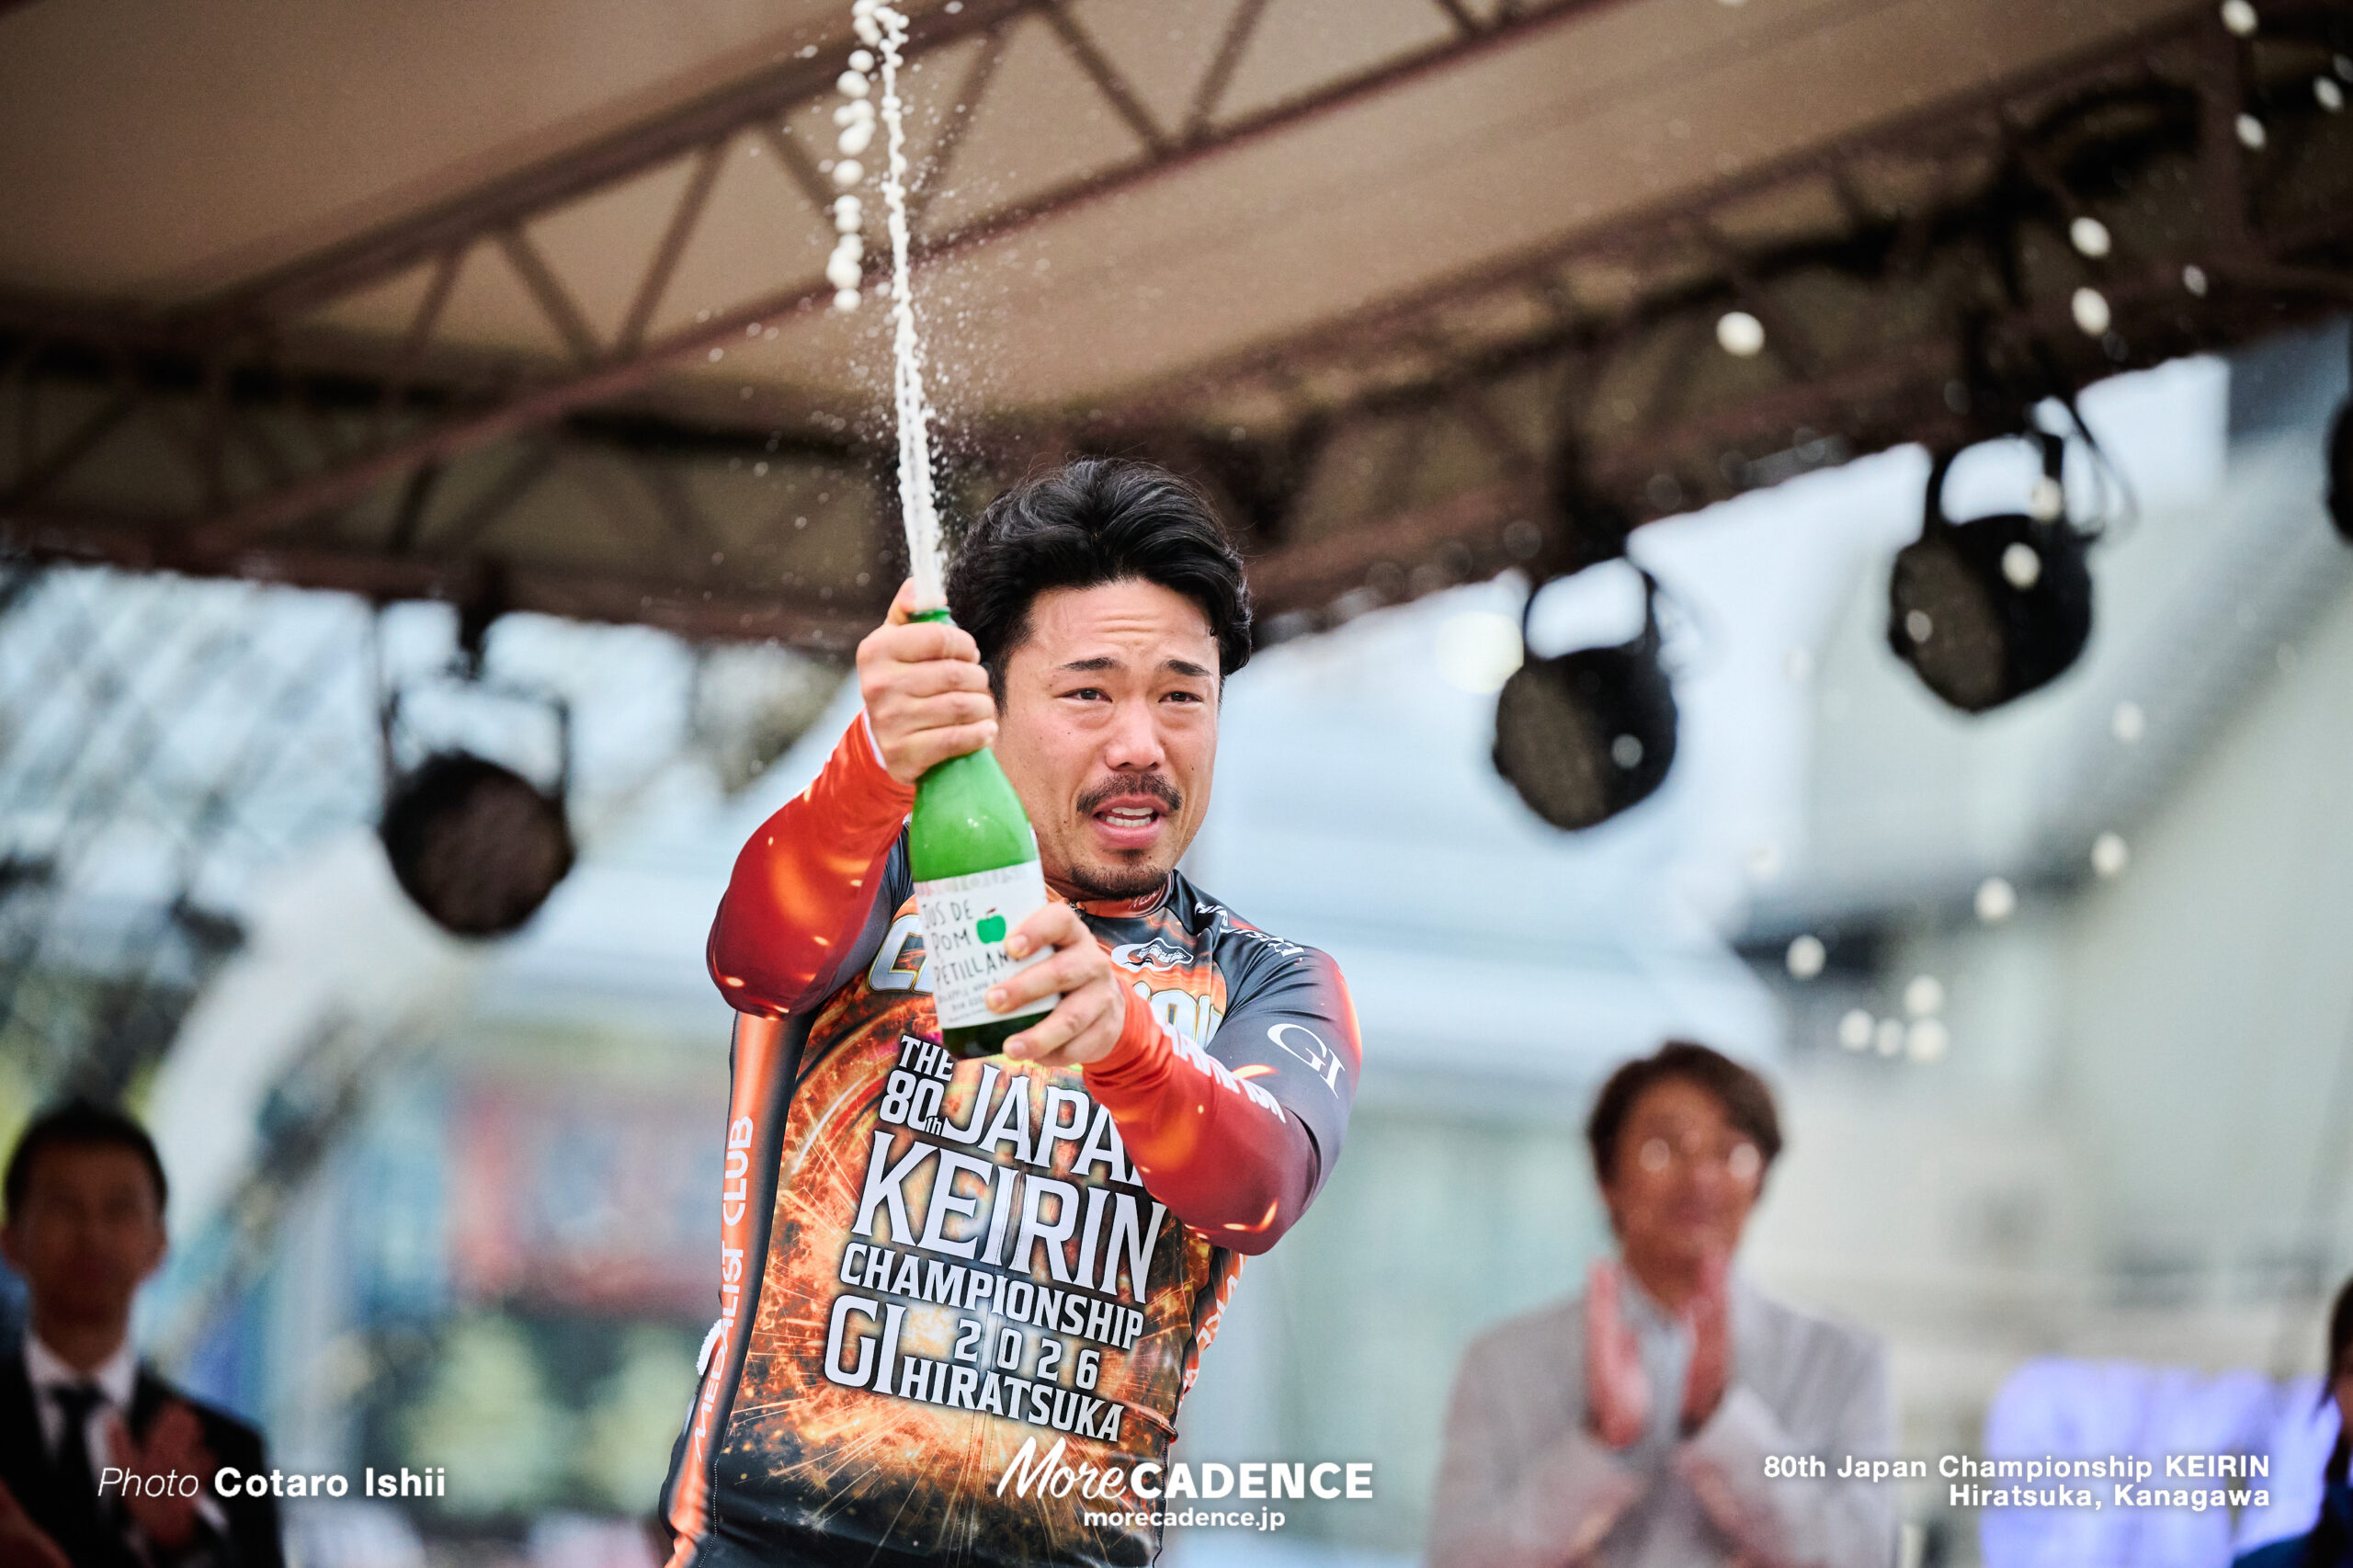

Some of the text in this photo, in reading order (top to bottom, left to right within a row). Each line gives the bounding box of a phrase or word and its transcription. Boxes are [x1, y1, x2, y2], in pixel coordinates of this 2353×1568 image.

[930, 927, 972, 959] POM
[949, 899, 973, 921] DE
[898, 1035, 954, 1082] THE
[722, 1115, 754, 1227] CLUB
[940, 1062, 1143, 1187] JAPA
[851, 1131, 1167, 1304] KEIRIN
[840, 1243, 1145, 1350] CHAMPIONSHIP
[902, 1356, 1125, 1443] HIRATSUKA
